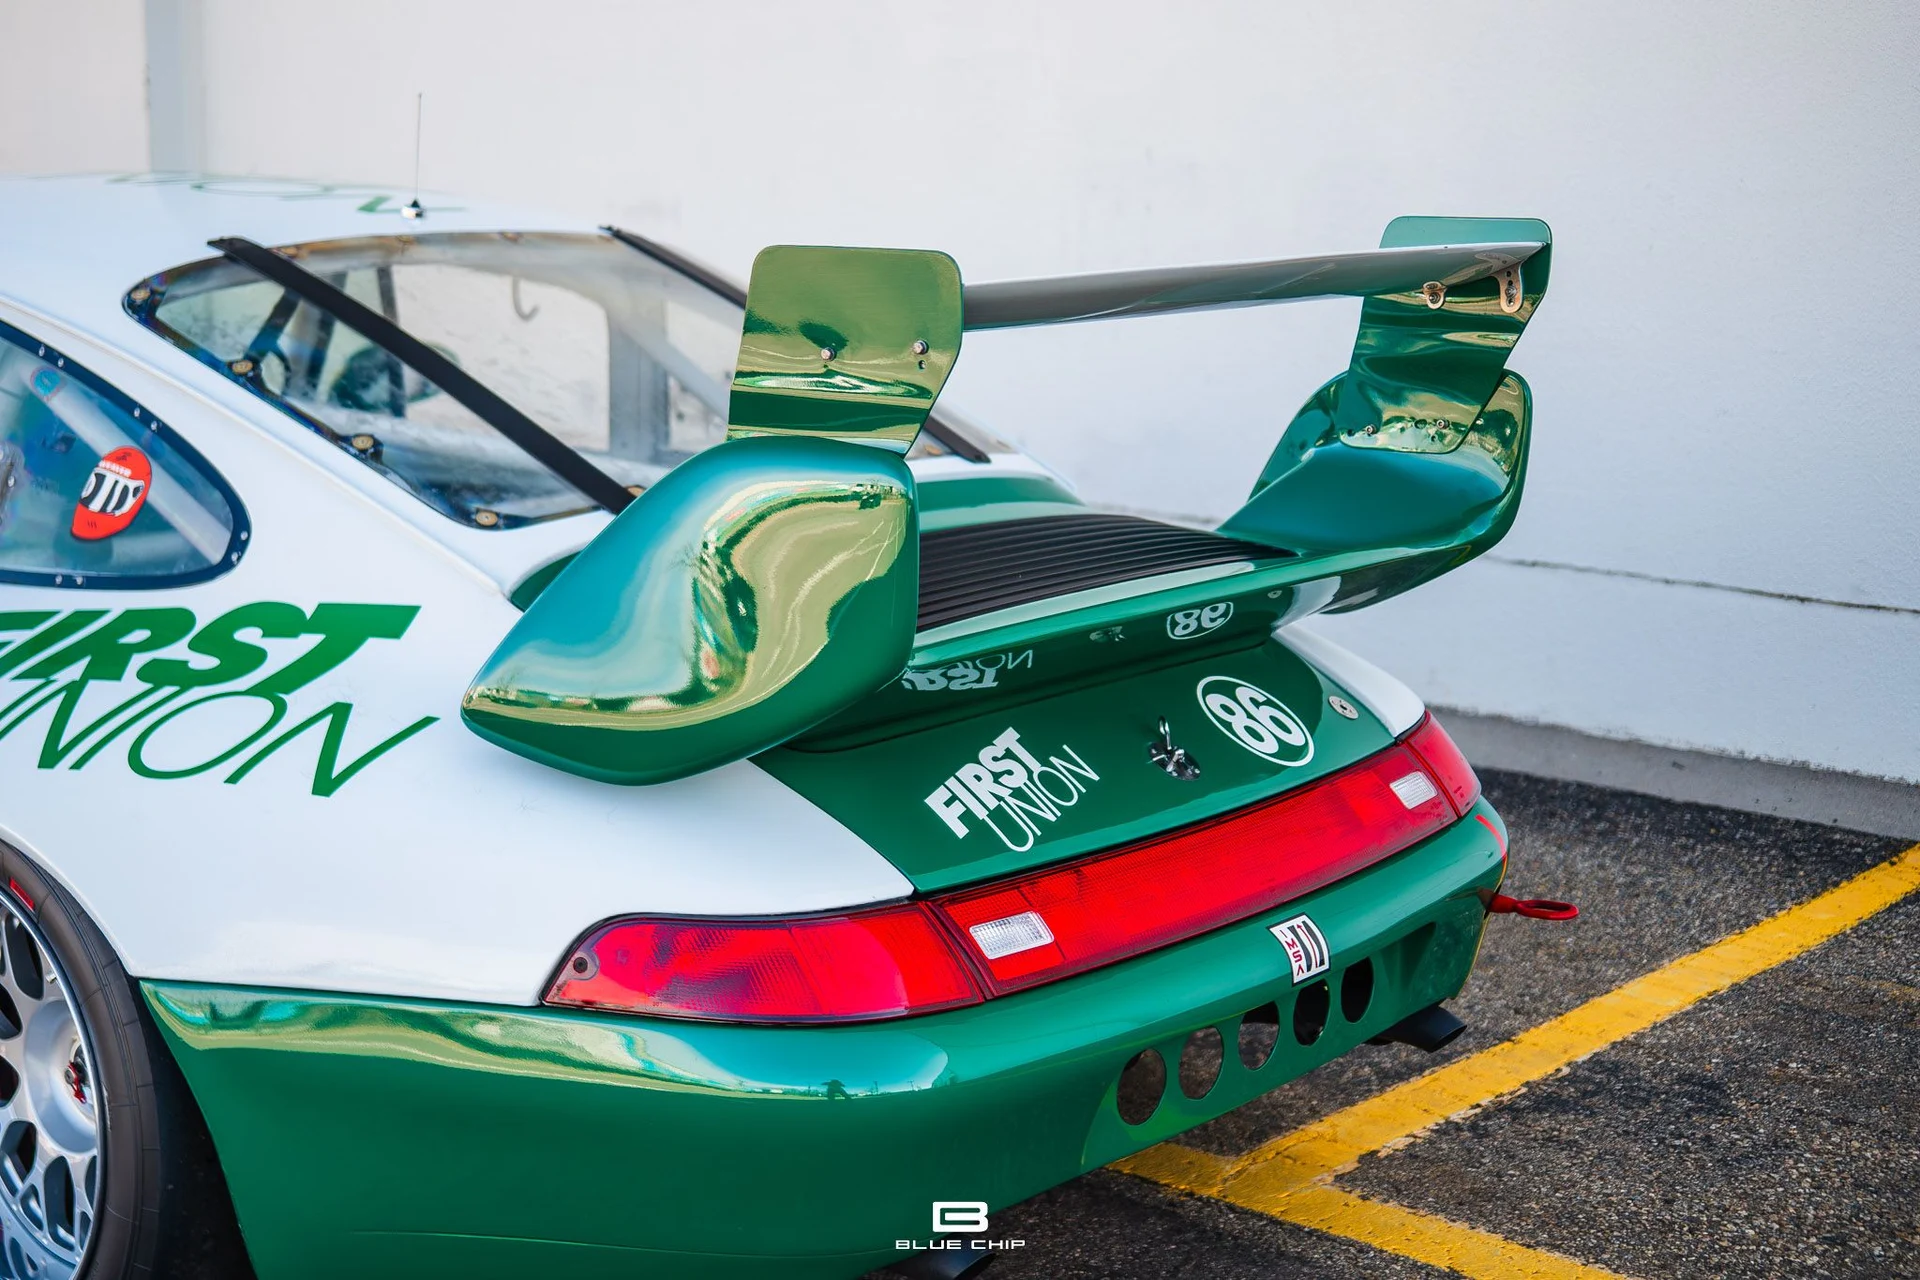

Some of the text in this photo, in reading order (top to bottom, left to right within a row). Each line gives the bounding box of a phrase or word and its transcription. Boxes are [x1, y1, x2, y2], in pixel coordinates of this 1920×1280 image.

[1205, 686, 1306, 754] 86
[924, 726, 1042, 839] FIRST
[983, 744, 1101, 852] UNION
